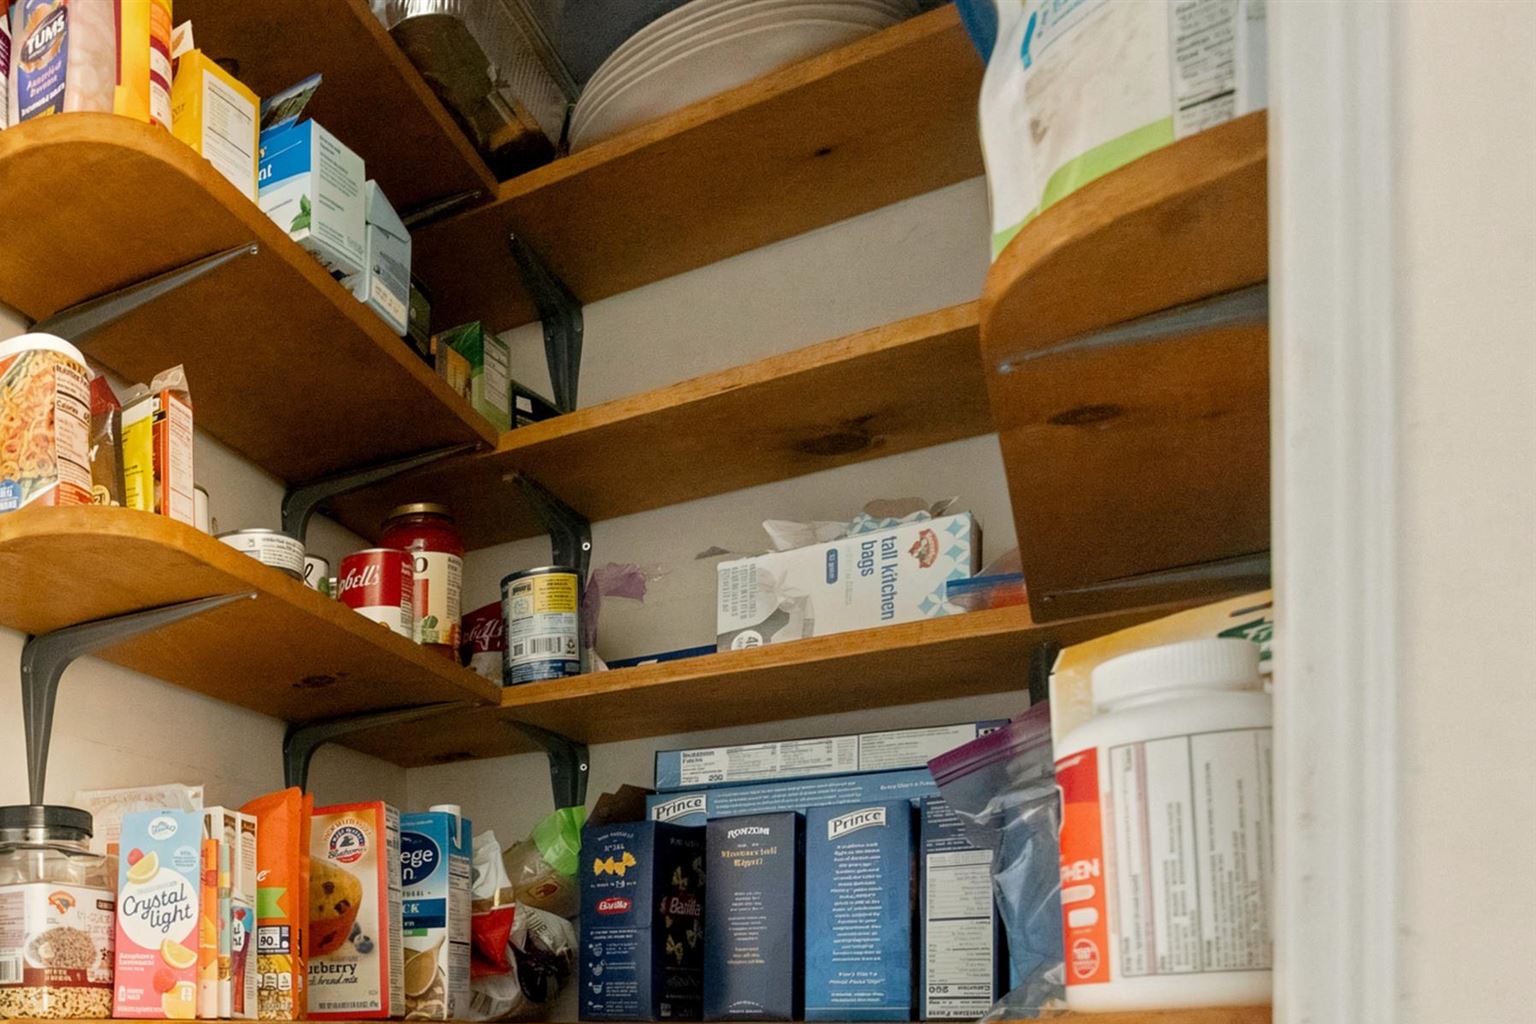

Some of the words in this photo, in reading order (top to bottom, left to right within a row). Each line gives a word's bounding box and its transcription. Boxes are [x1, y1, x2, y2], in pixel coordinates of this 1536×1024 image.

[26, 14, 65, 53] TUMS
[857, 540, 877, 577] bags
[880, 535, 898, 562] tall
[338, 564, 381, 594] pbell's
[880, 564, 898, 621] kitchen
[654, 797, 702, 820] Prince
[833, 812, 881, 833] Prince
[727, 826, 770, 839] RONZONI
[123, 883, 188, 920] Crystal
[598, 901, 629, 912] Barilla
[150, 904, 193, 934] light
